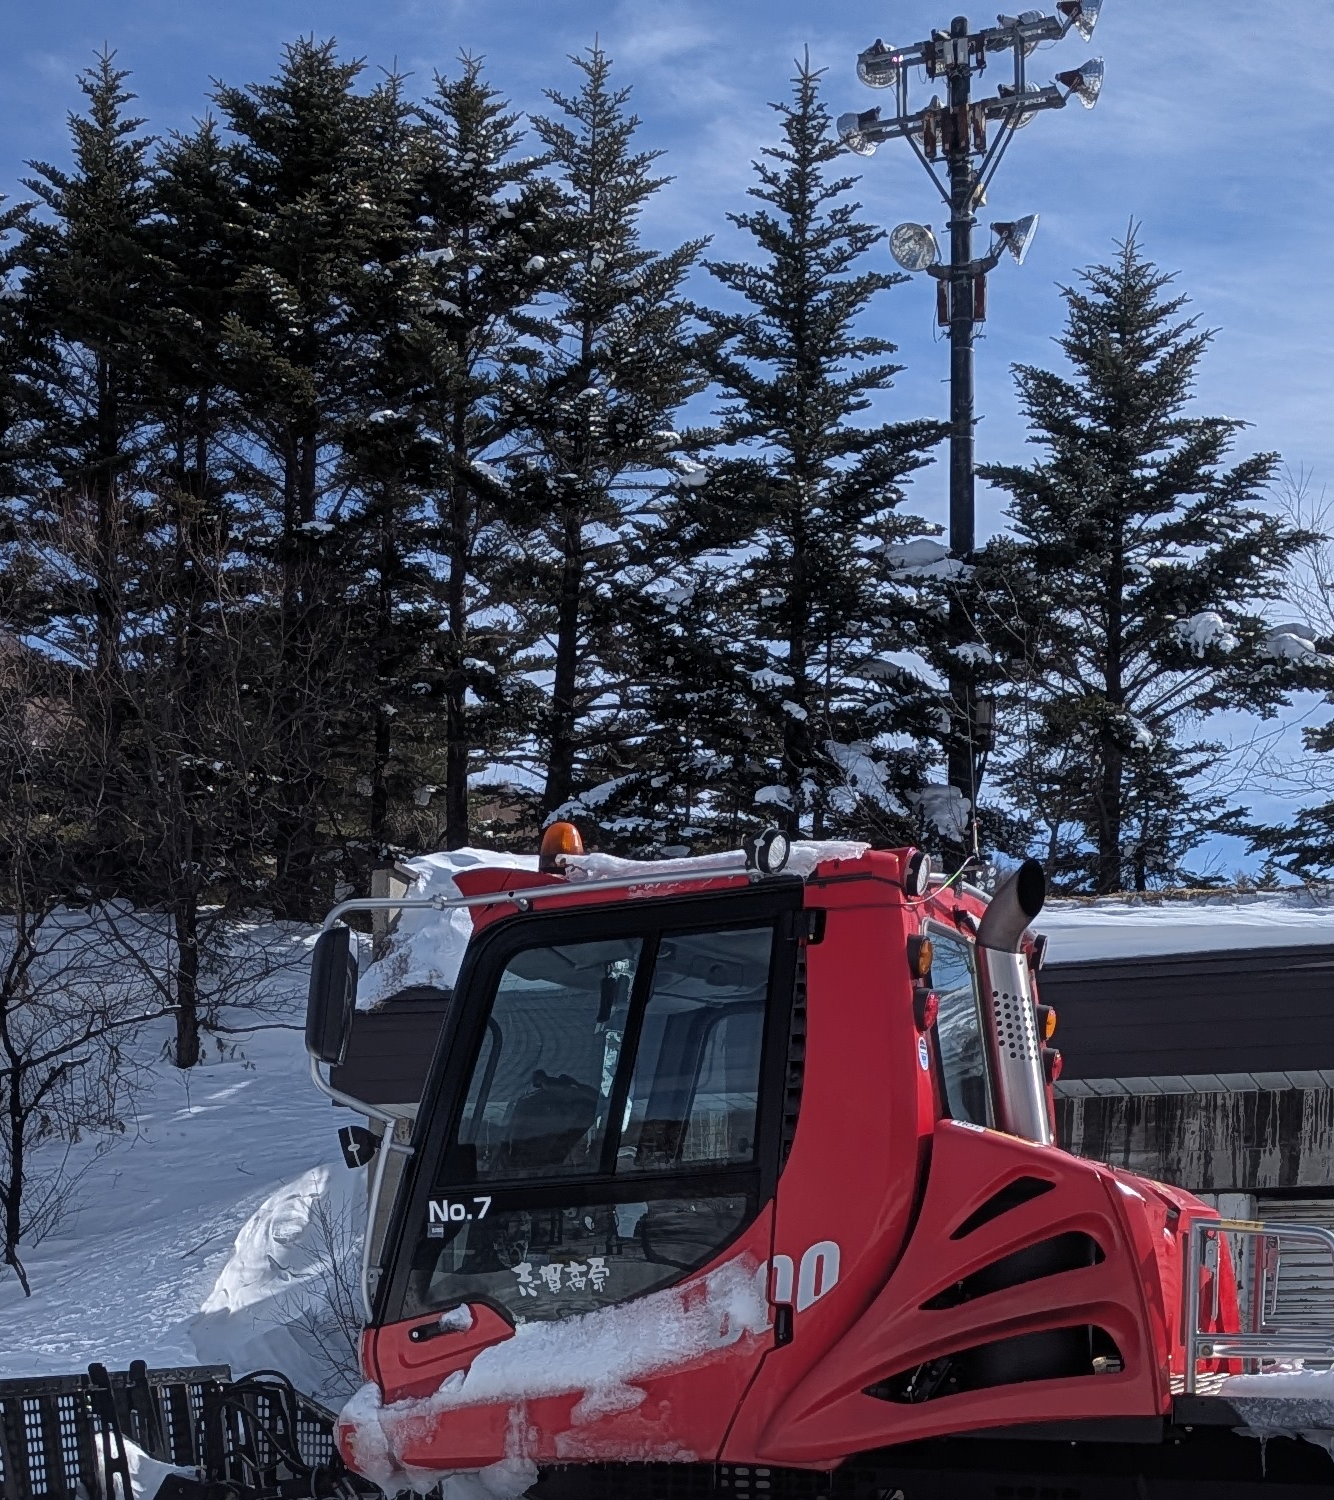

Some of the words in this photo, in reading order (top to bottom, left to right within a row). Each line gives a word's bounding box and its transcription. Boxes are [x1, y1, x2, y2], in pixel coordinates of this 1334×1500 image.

[428, 1196, 492, 1222] No.7
[510, 1257, 610, 1297] 志賀高原
